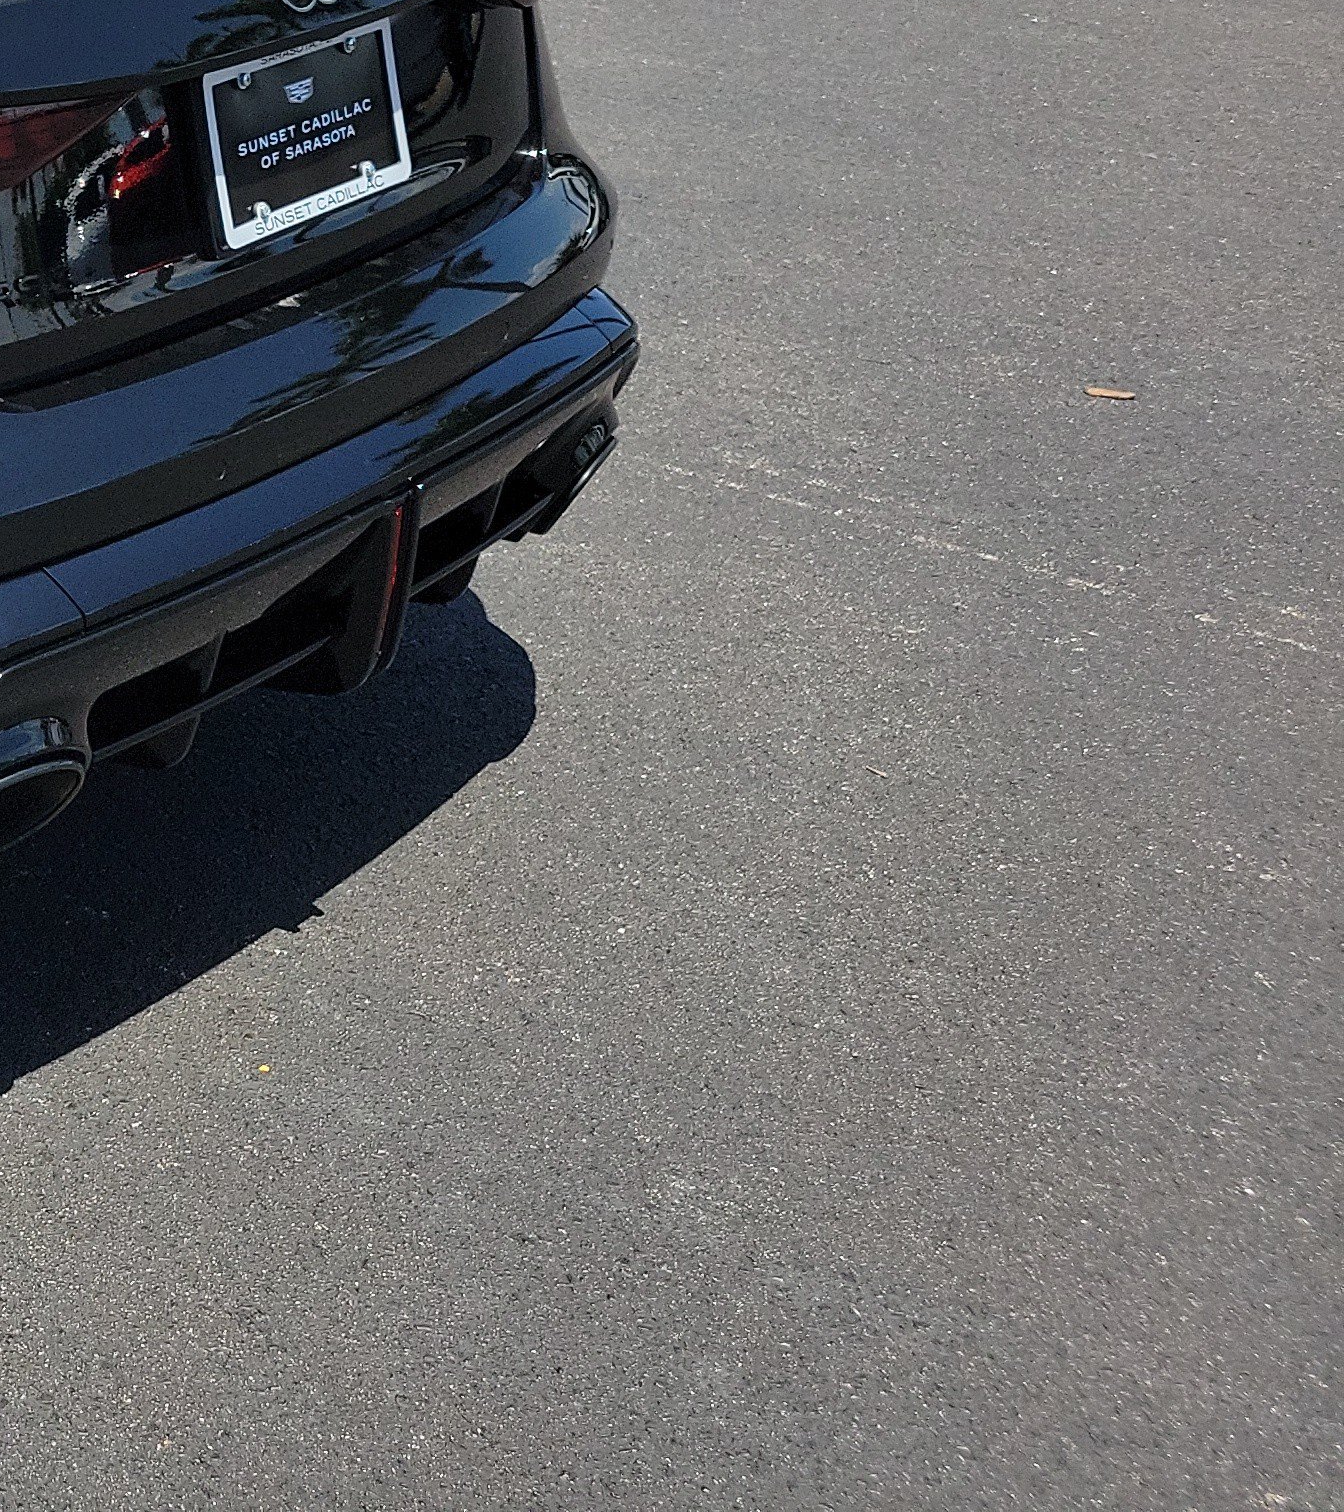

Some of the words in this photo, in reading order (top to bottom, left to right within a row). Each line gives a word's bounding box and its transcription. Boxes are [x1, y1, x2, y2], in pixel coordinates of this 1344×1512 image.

[237, 124, 297, 157] SUNSET
[301, 98, 372, 134] CADILLAC
[260, 151, 281, 169] OF
[285, 124, 356, 160] SARASOTA
[254, 201, 312, 236] SUNSET
[316, 175, 385, 211] CADILLAC
